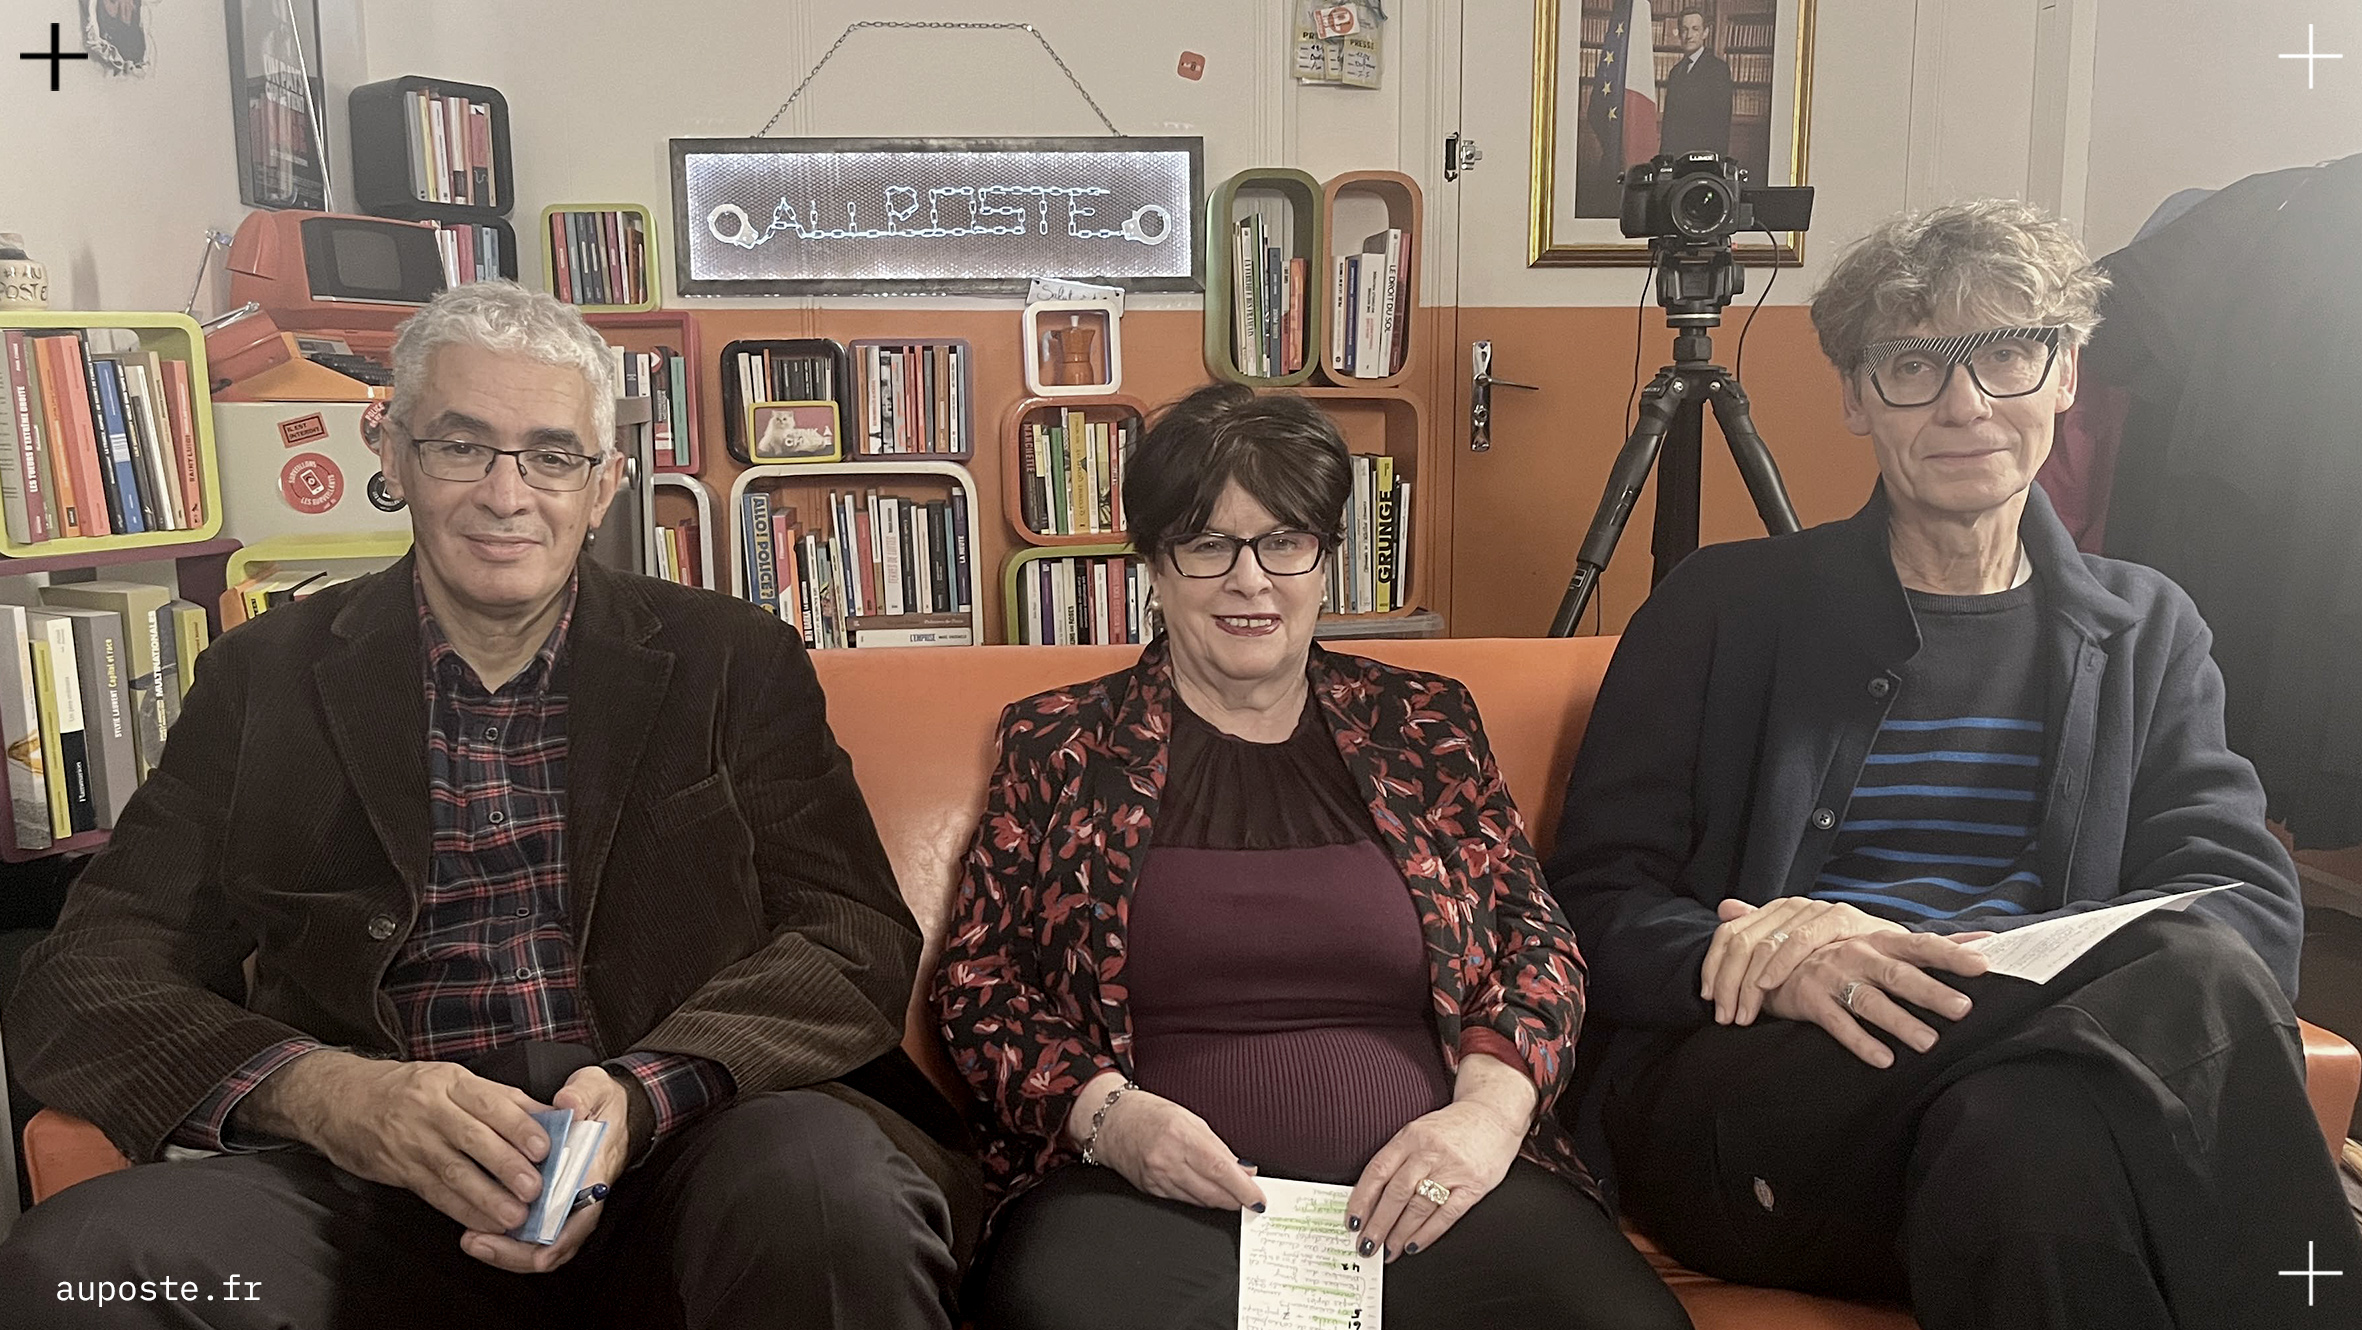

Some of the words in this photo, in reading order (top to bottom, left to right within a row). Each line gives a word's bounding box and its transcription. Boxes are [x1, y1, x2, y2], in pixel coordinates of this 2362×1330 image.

[1389, 264, 1396, 273] LE
[1386, 276, 1395, 301] DROIT
[1385, 303, 1393, 315] DU
[1384, 317, 1392, 332] SOL
[18, 385, 28, 412] DROITE
[20, 413, 33, 450] D'EXTRÊME
[1024, 423, 1035, 472] MANCHETTE
[26, 450, 36, 479] TUEURS
[30, 479, 38, 492] LES
[753, 496, 768, 537] ALLO!
[1378, 490, 1392, 583] GRUNGE
[758, 540, 774, 598] POLICE?
[959, 555, 965, 563] LA
[104, 638, 113, 654] race
[106, 654, 114, 662] et
[147, 610, 163, 697] MULTINATIONALES
[106, 663, 117, 687] Capital
[109, 689, 120, 716] LAURENT
[112, 717, 122, 737] SYLVIE
